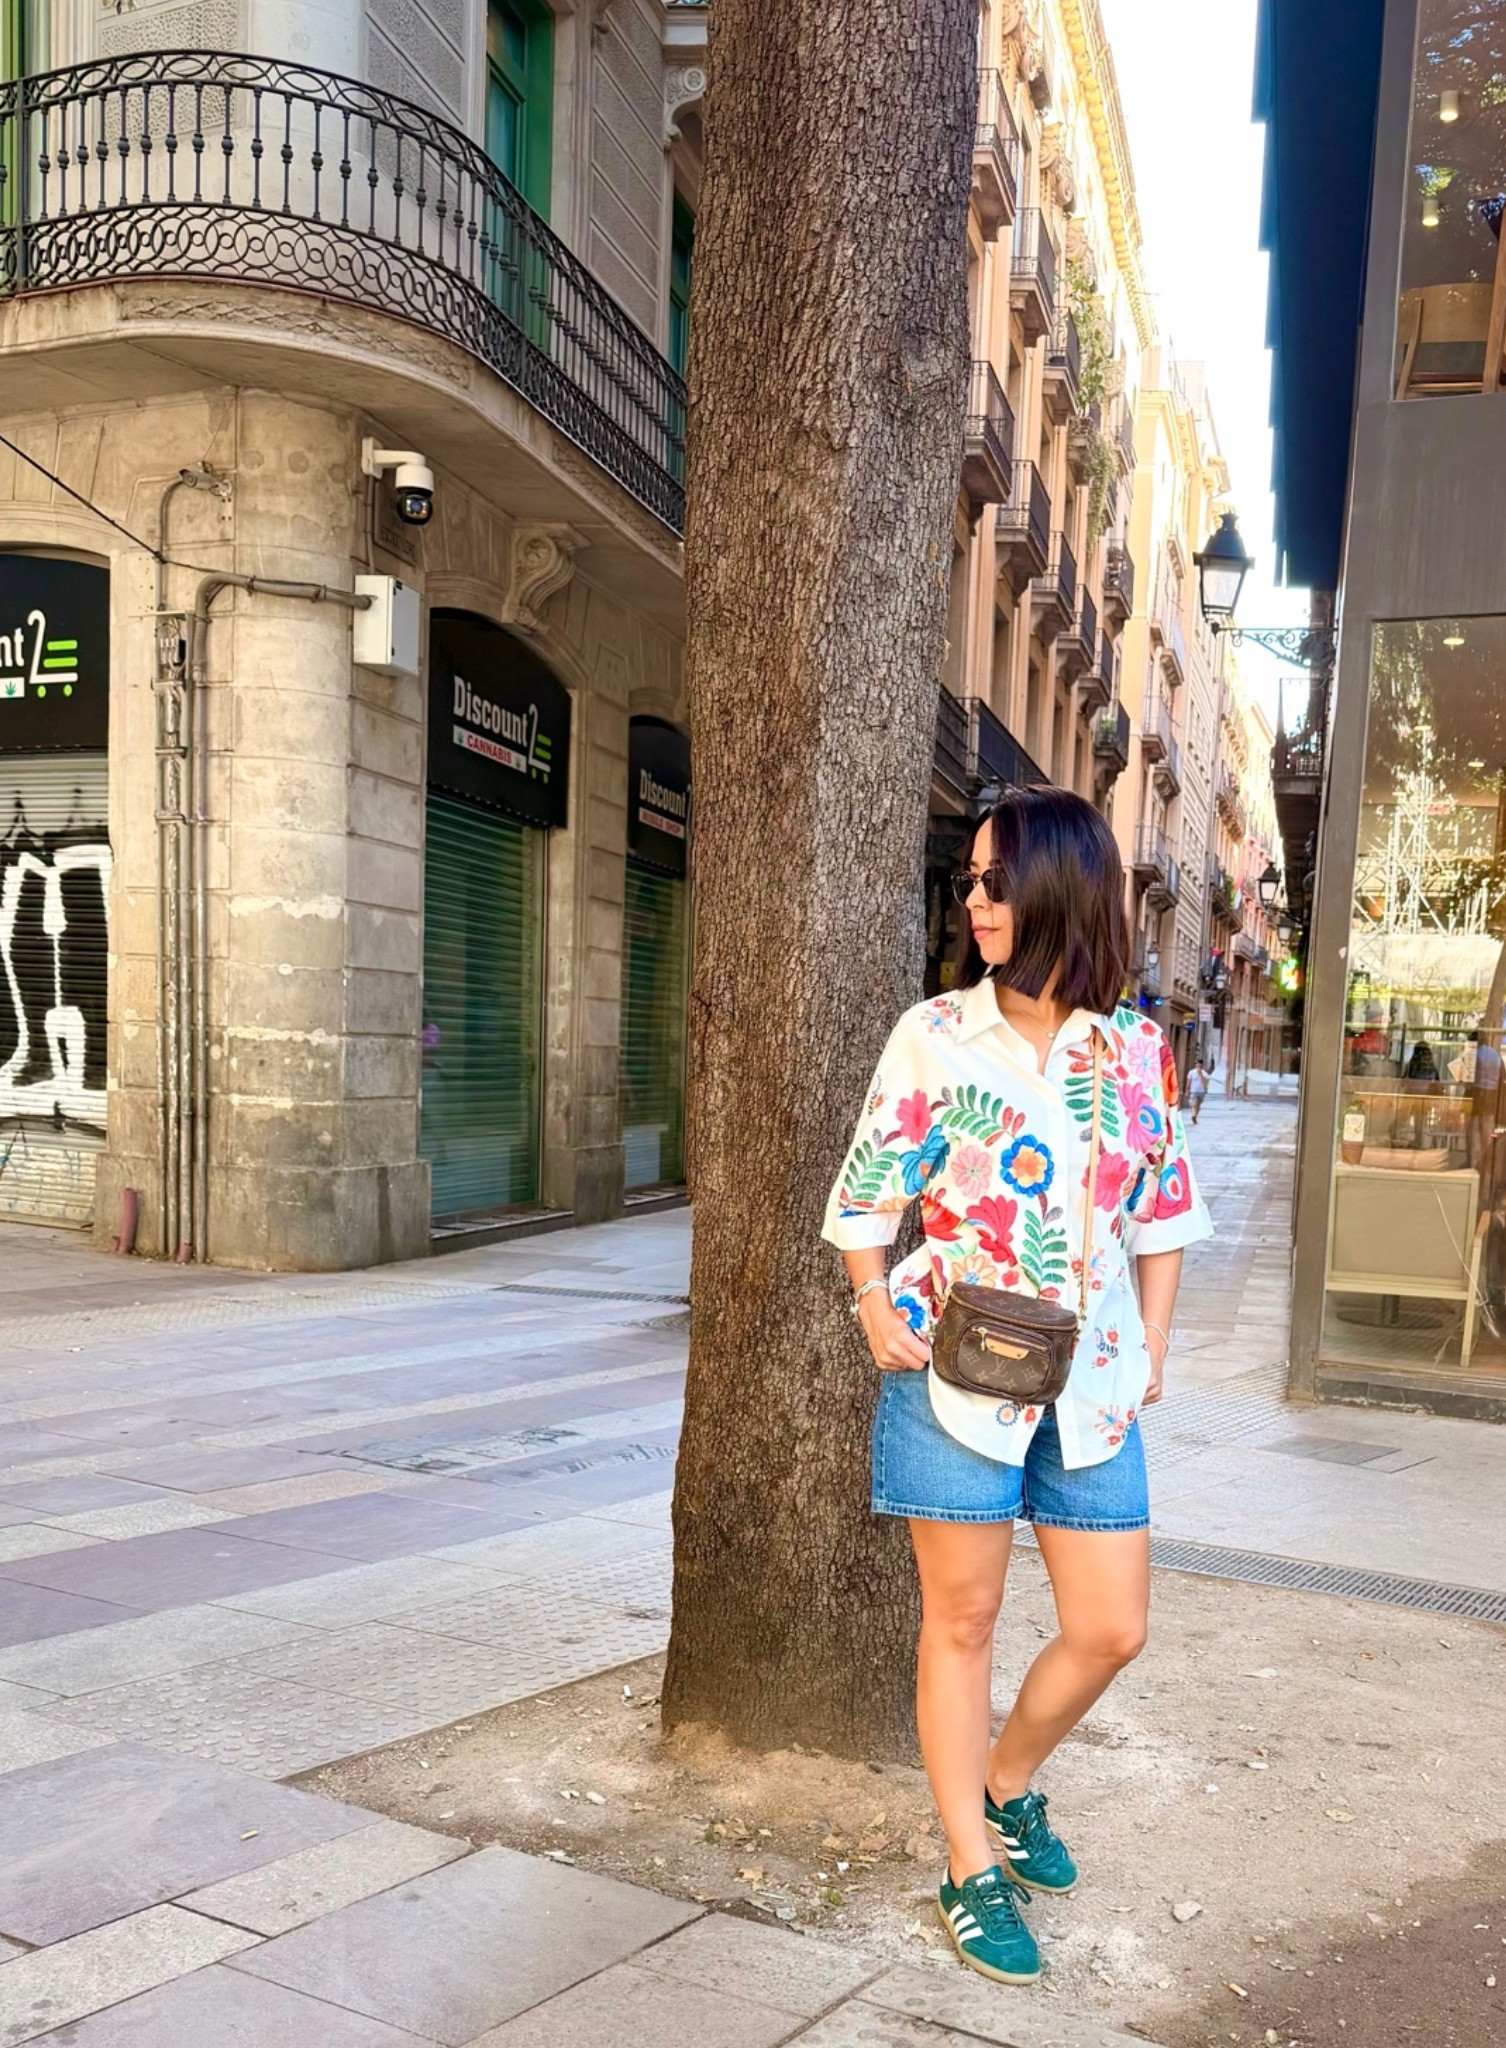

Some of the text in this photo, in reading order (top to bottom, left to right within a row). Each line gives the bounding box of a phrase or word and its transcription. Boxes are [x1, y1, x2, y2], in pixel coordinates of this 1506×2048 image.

[453, 674, 528, 748] Discount
[467, 733, 512, 765] CANNABIS
[640, 768, 686, 819] Discount
